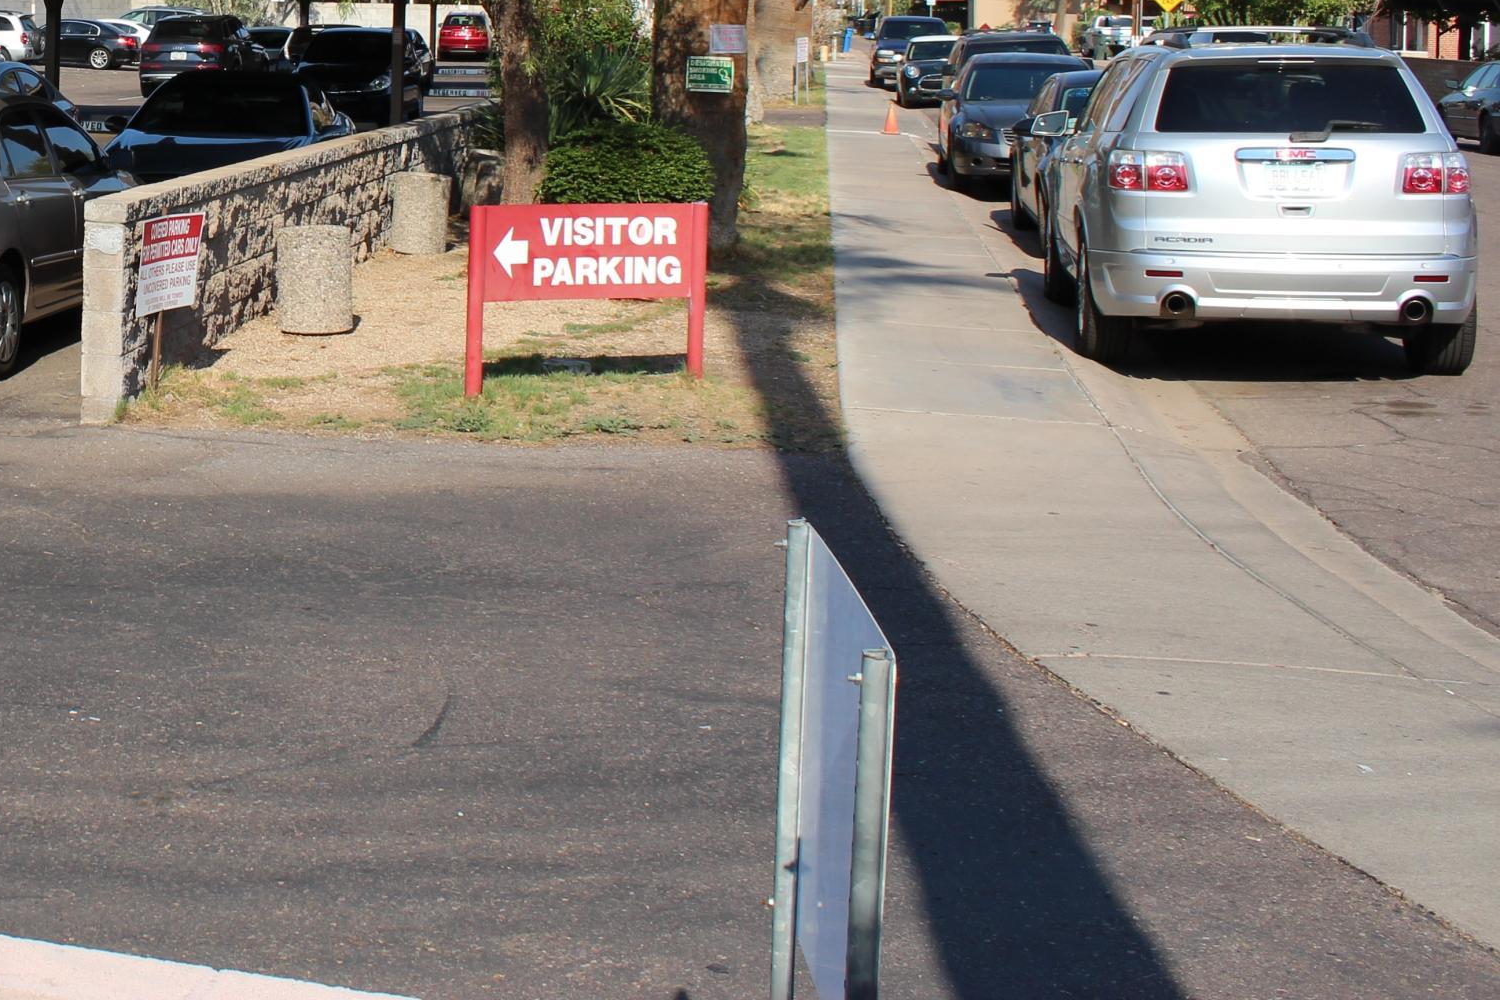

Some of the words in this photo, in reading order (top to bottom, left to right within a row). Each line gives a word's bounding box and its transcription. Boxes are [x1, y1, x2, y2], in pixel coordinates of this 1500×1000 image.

[168, 218, 191, 237] PARKING
[539, 216, 677, 246] VISITOR
[172, 238, 185, 256] CARS
[185, 236, 199, 254] ONLY
[165, 261, 185, 276] PLEASE
[185, 260, 196, 271] USE
[532, 256, 682, 287] PARKING
[169, 275, 191, 289] PARKING
